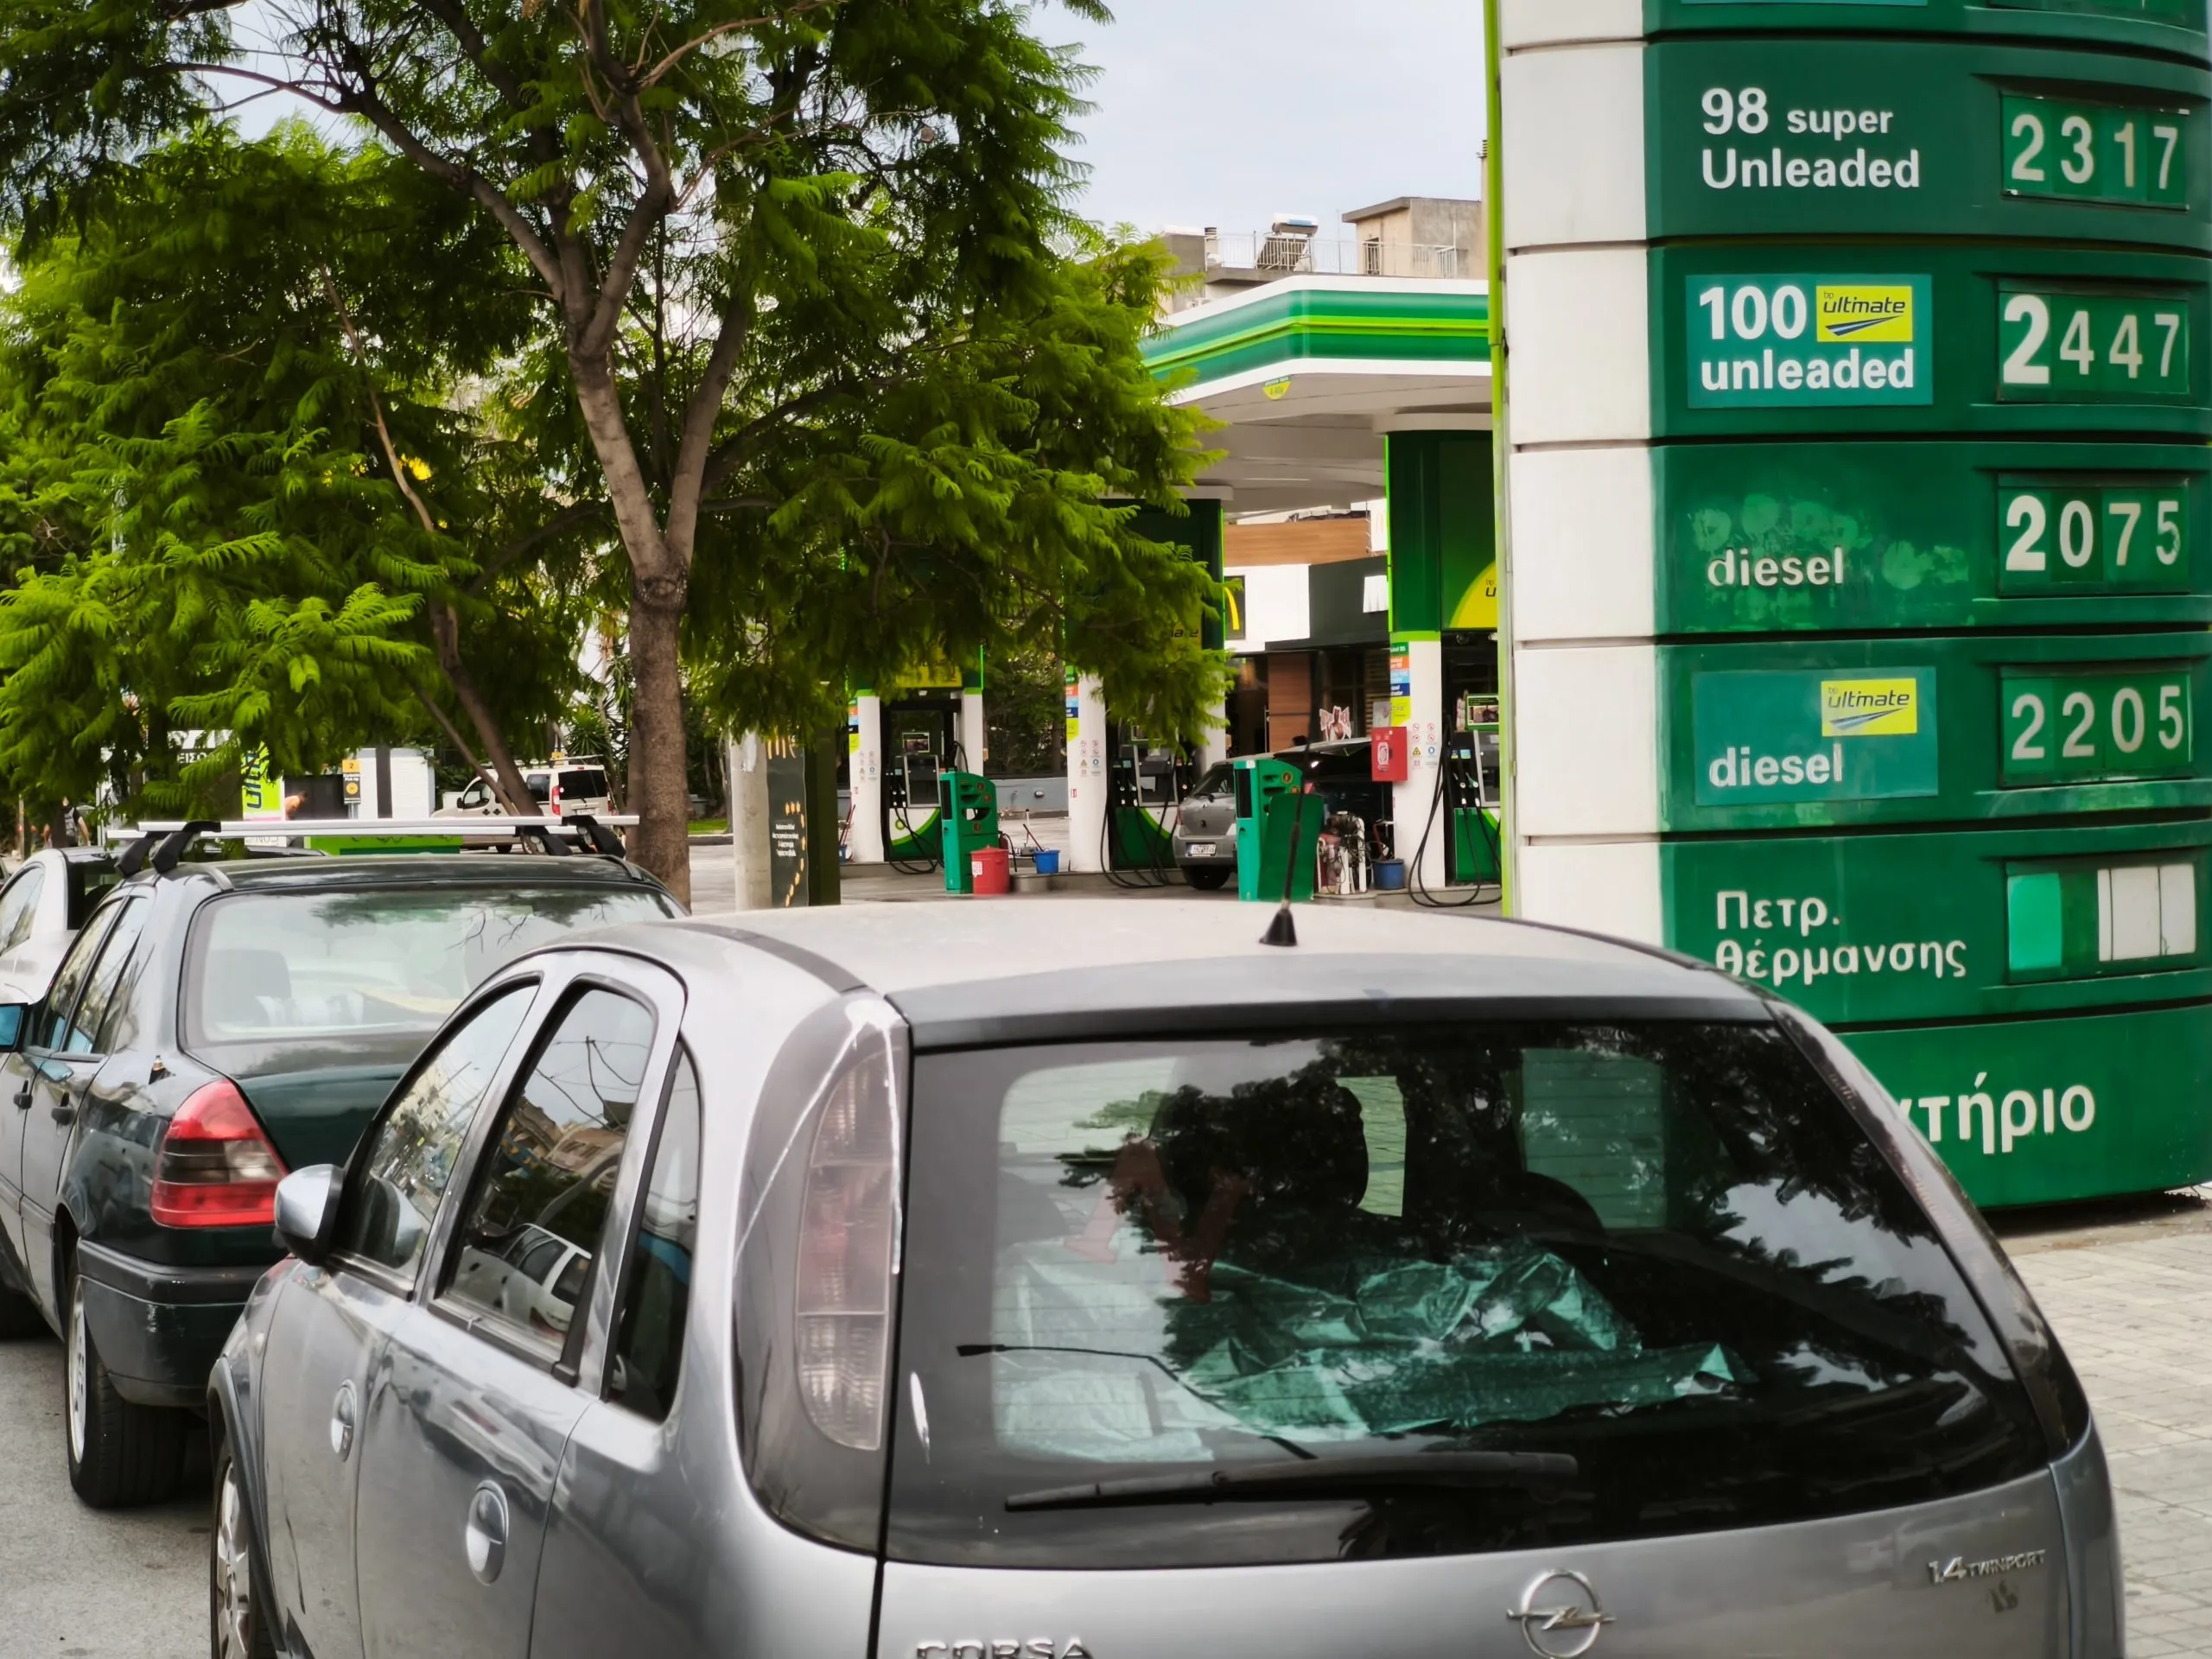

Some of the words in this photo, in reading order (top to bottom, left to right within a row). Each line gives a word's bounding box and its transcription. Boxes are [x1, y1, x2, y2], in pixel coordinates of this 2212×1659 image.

[1701, 87, 1769, 135] 98
[1786, 108, 1894, 141] super
[1701, 149, 1921, 189] Unleaded
[2011, 113, 2179, 190] 2317
[1699, 285, 1808, 341] 100
[1822, 296, 1906, 314] ultimate
[1823, 291, 1834, 300] bp
[2002, 294, 2180, 385] 2447
[1700, 349, 1915, 391] unleaded
[2005, 494, 2182, 572] 2075
[1706, 545, 1845, 587] diesel
[1827, 690, 1910, 709] ultimate
[2011, 685, 2184, 761] 2205
[1707, 742, 1844, 788] diesel
[1717, 890, 1840, 937] Πετρ.
[1715, 938, 1967, 987] θέρμανσης
[1967, 1548, 2046, 1577] TWINPORT
